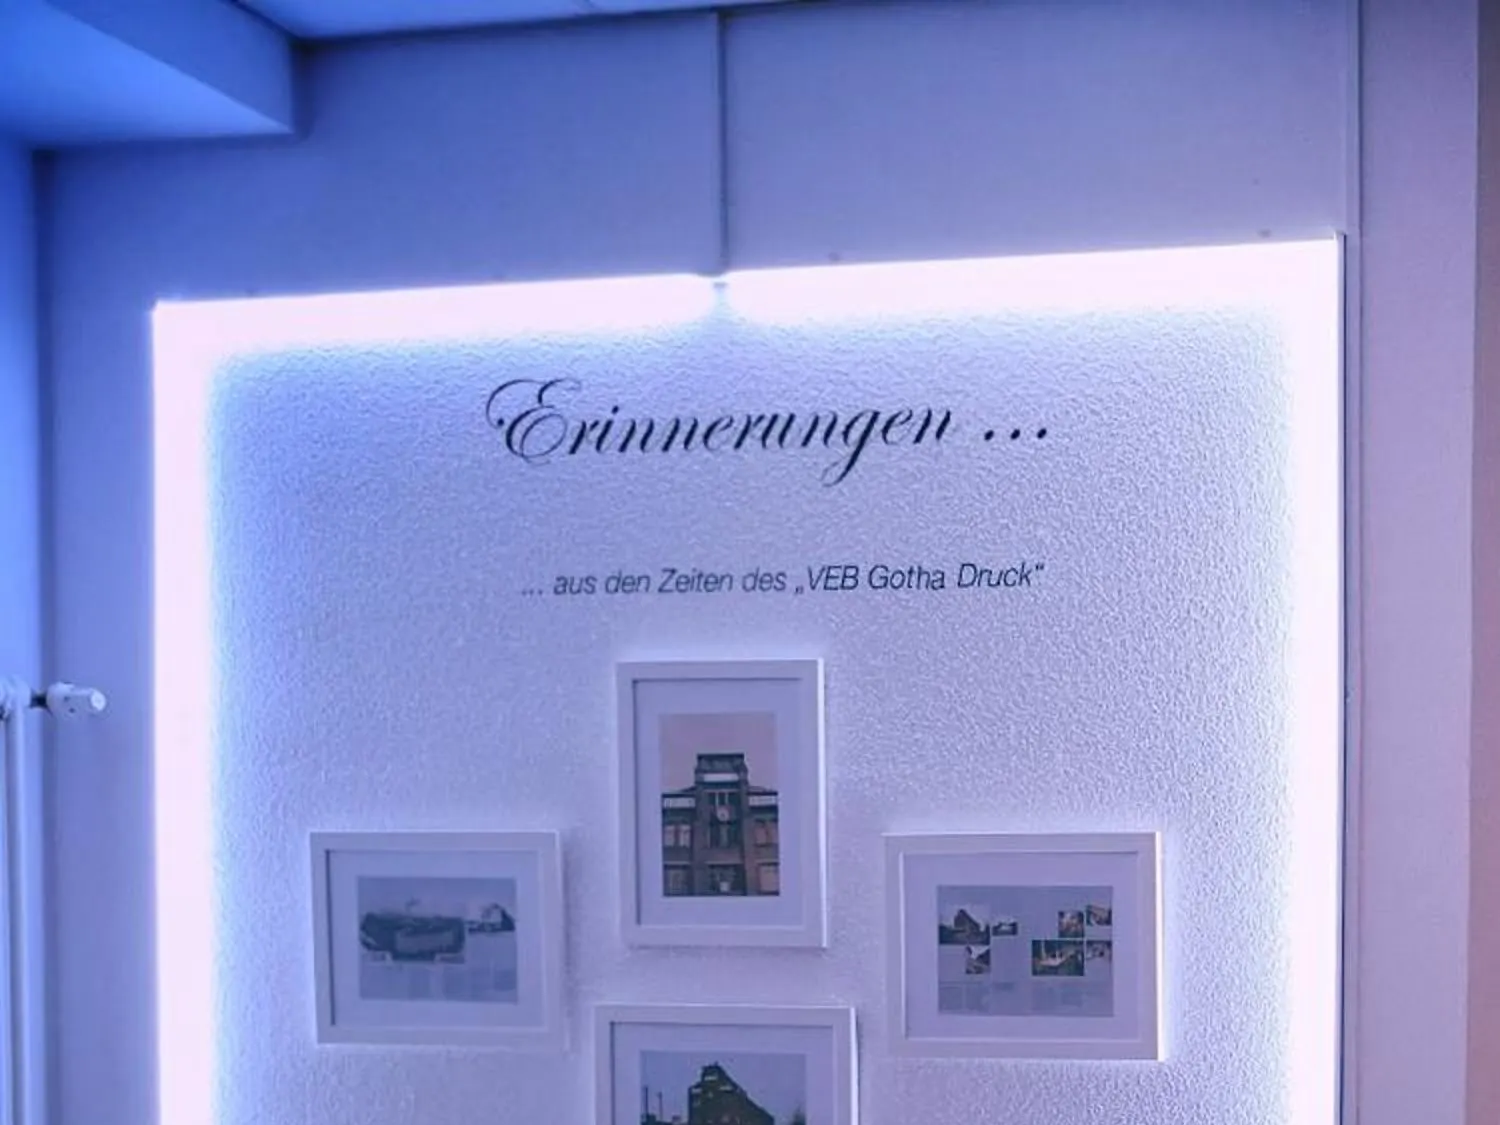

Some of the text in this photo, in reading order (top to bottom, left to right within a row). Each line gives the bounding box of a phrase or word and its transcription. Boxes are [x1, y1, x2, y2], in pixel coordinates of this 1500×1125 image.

[485, 377, 952, 488] Erinnerungen
[553, 574, 597, 596] aus
[605, 568, 650, 594] den
[657, 566, 734, 594] Zeiten
[742, 566, 788, 593] des
[868, 563, 946, 591] Gotha
